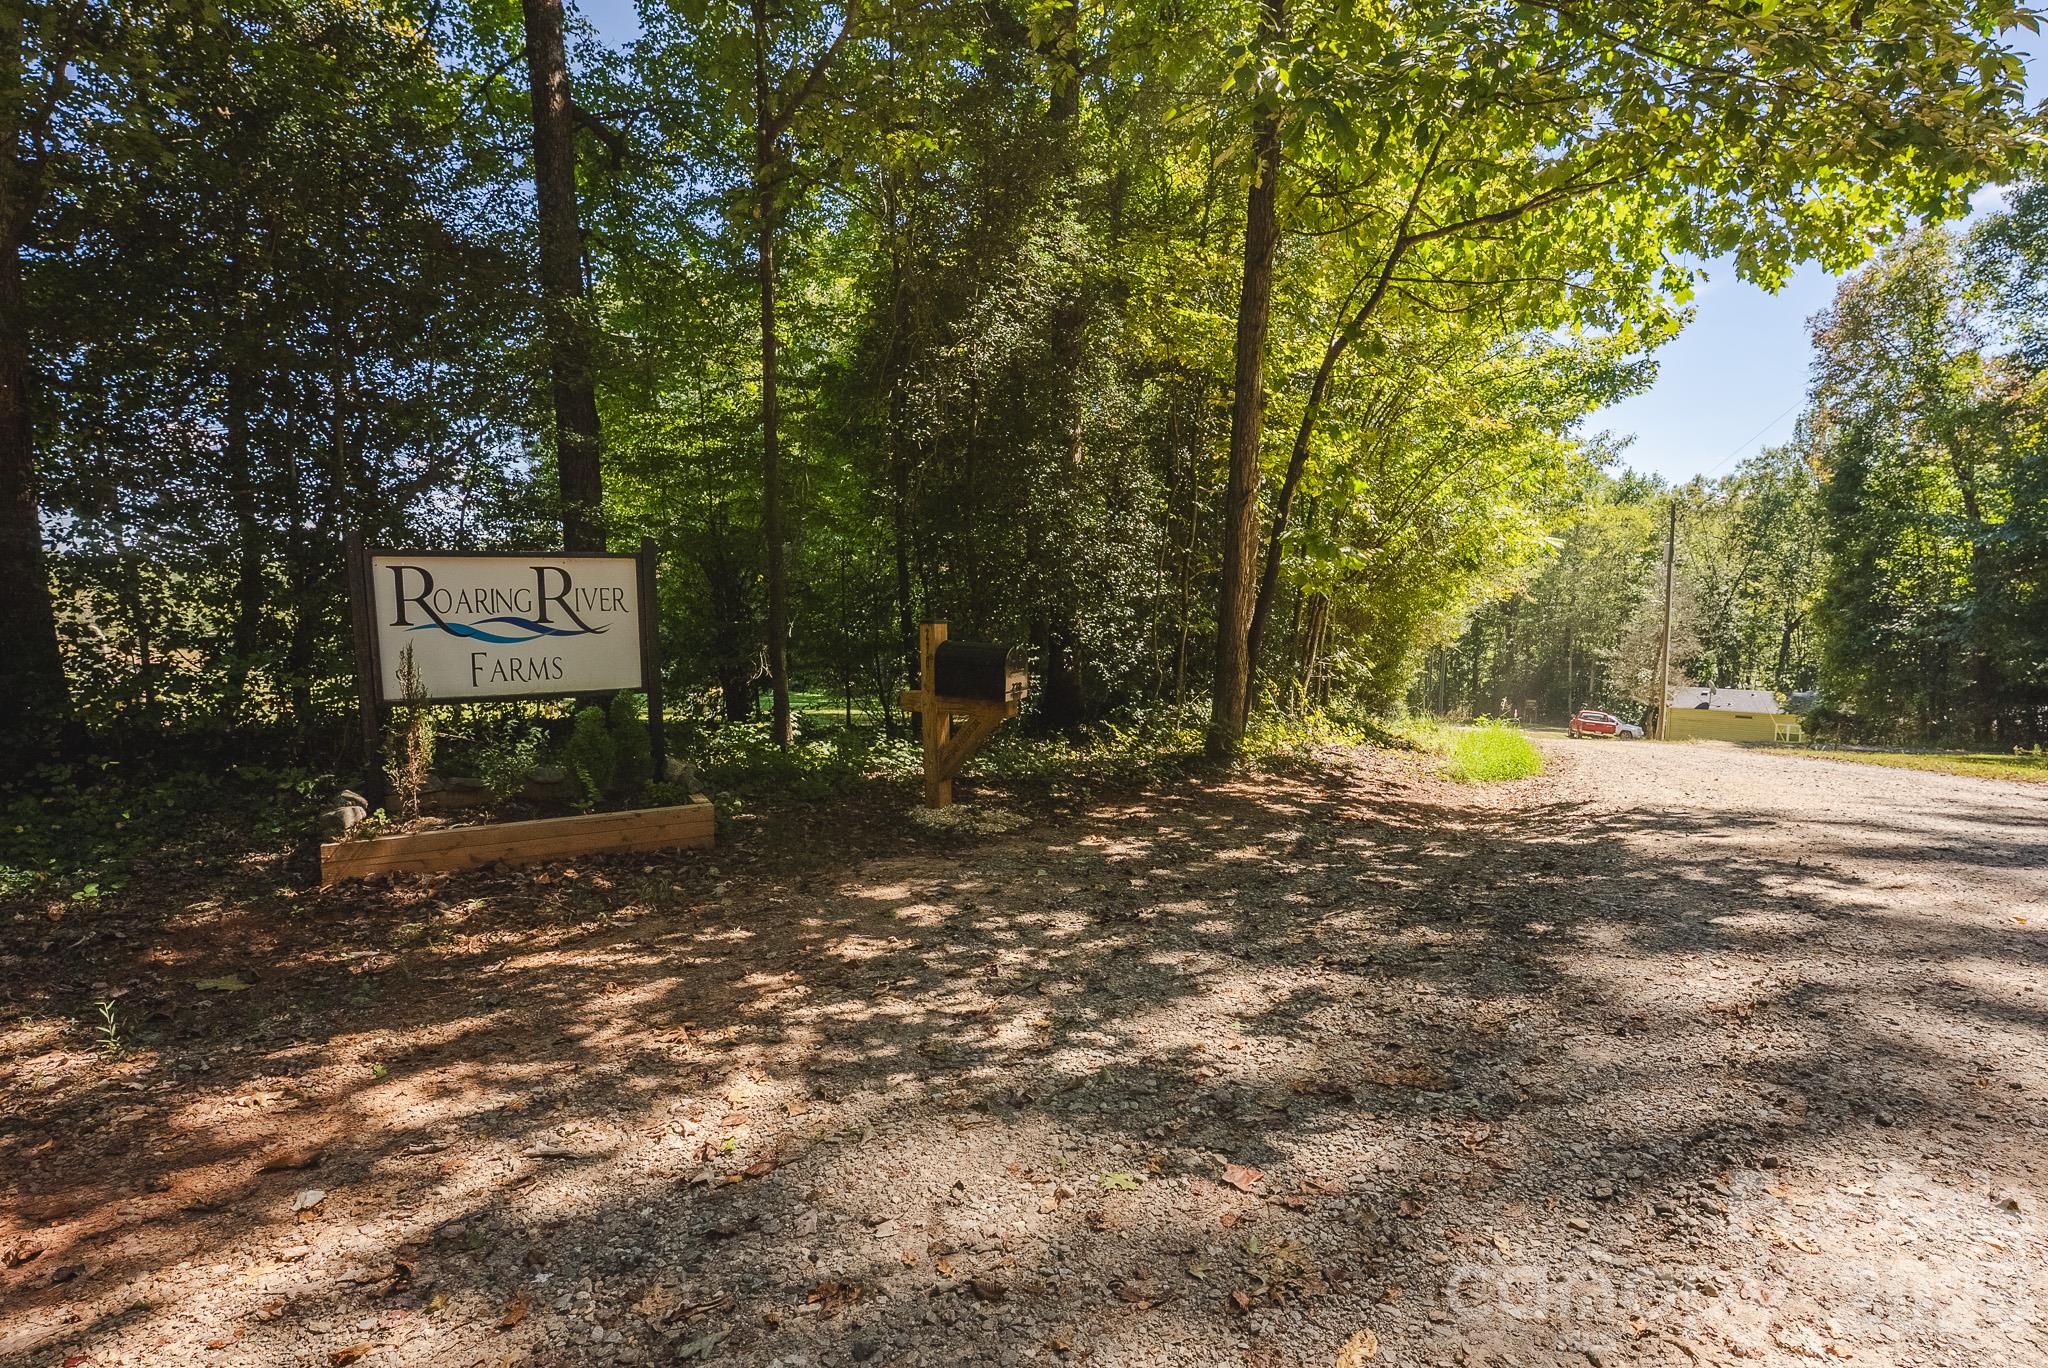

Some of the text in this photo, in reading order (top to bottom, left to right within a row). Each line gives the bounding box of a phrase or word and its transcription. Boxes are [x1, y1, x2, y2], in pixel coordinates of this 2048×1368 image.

[386, 565, 629, 637] ROARING RIVER
[471, 652, 563, 687] FARMS
